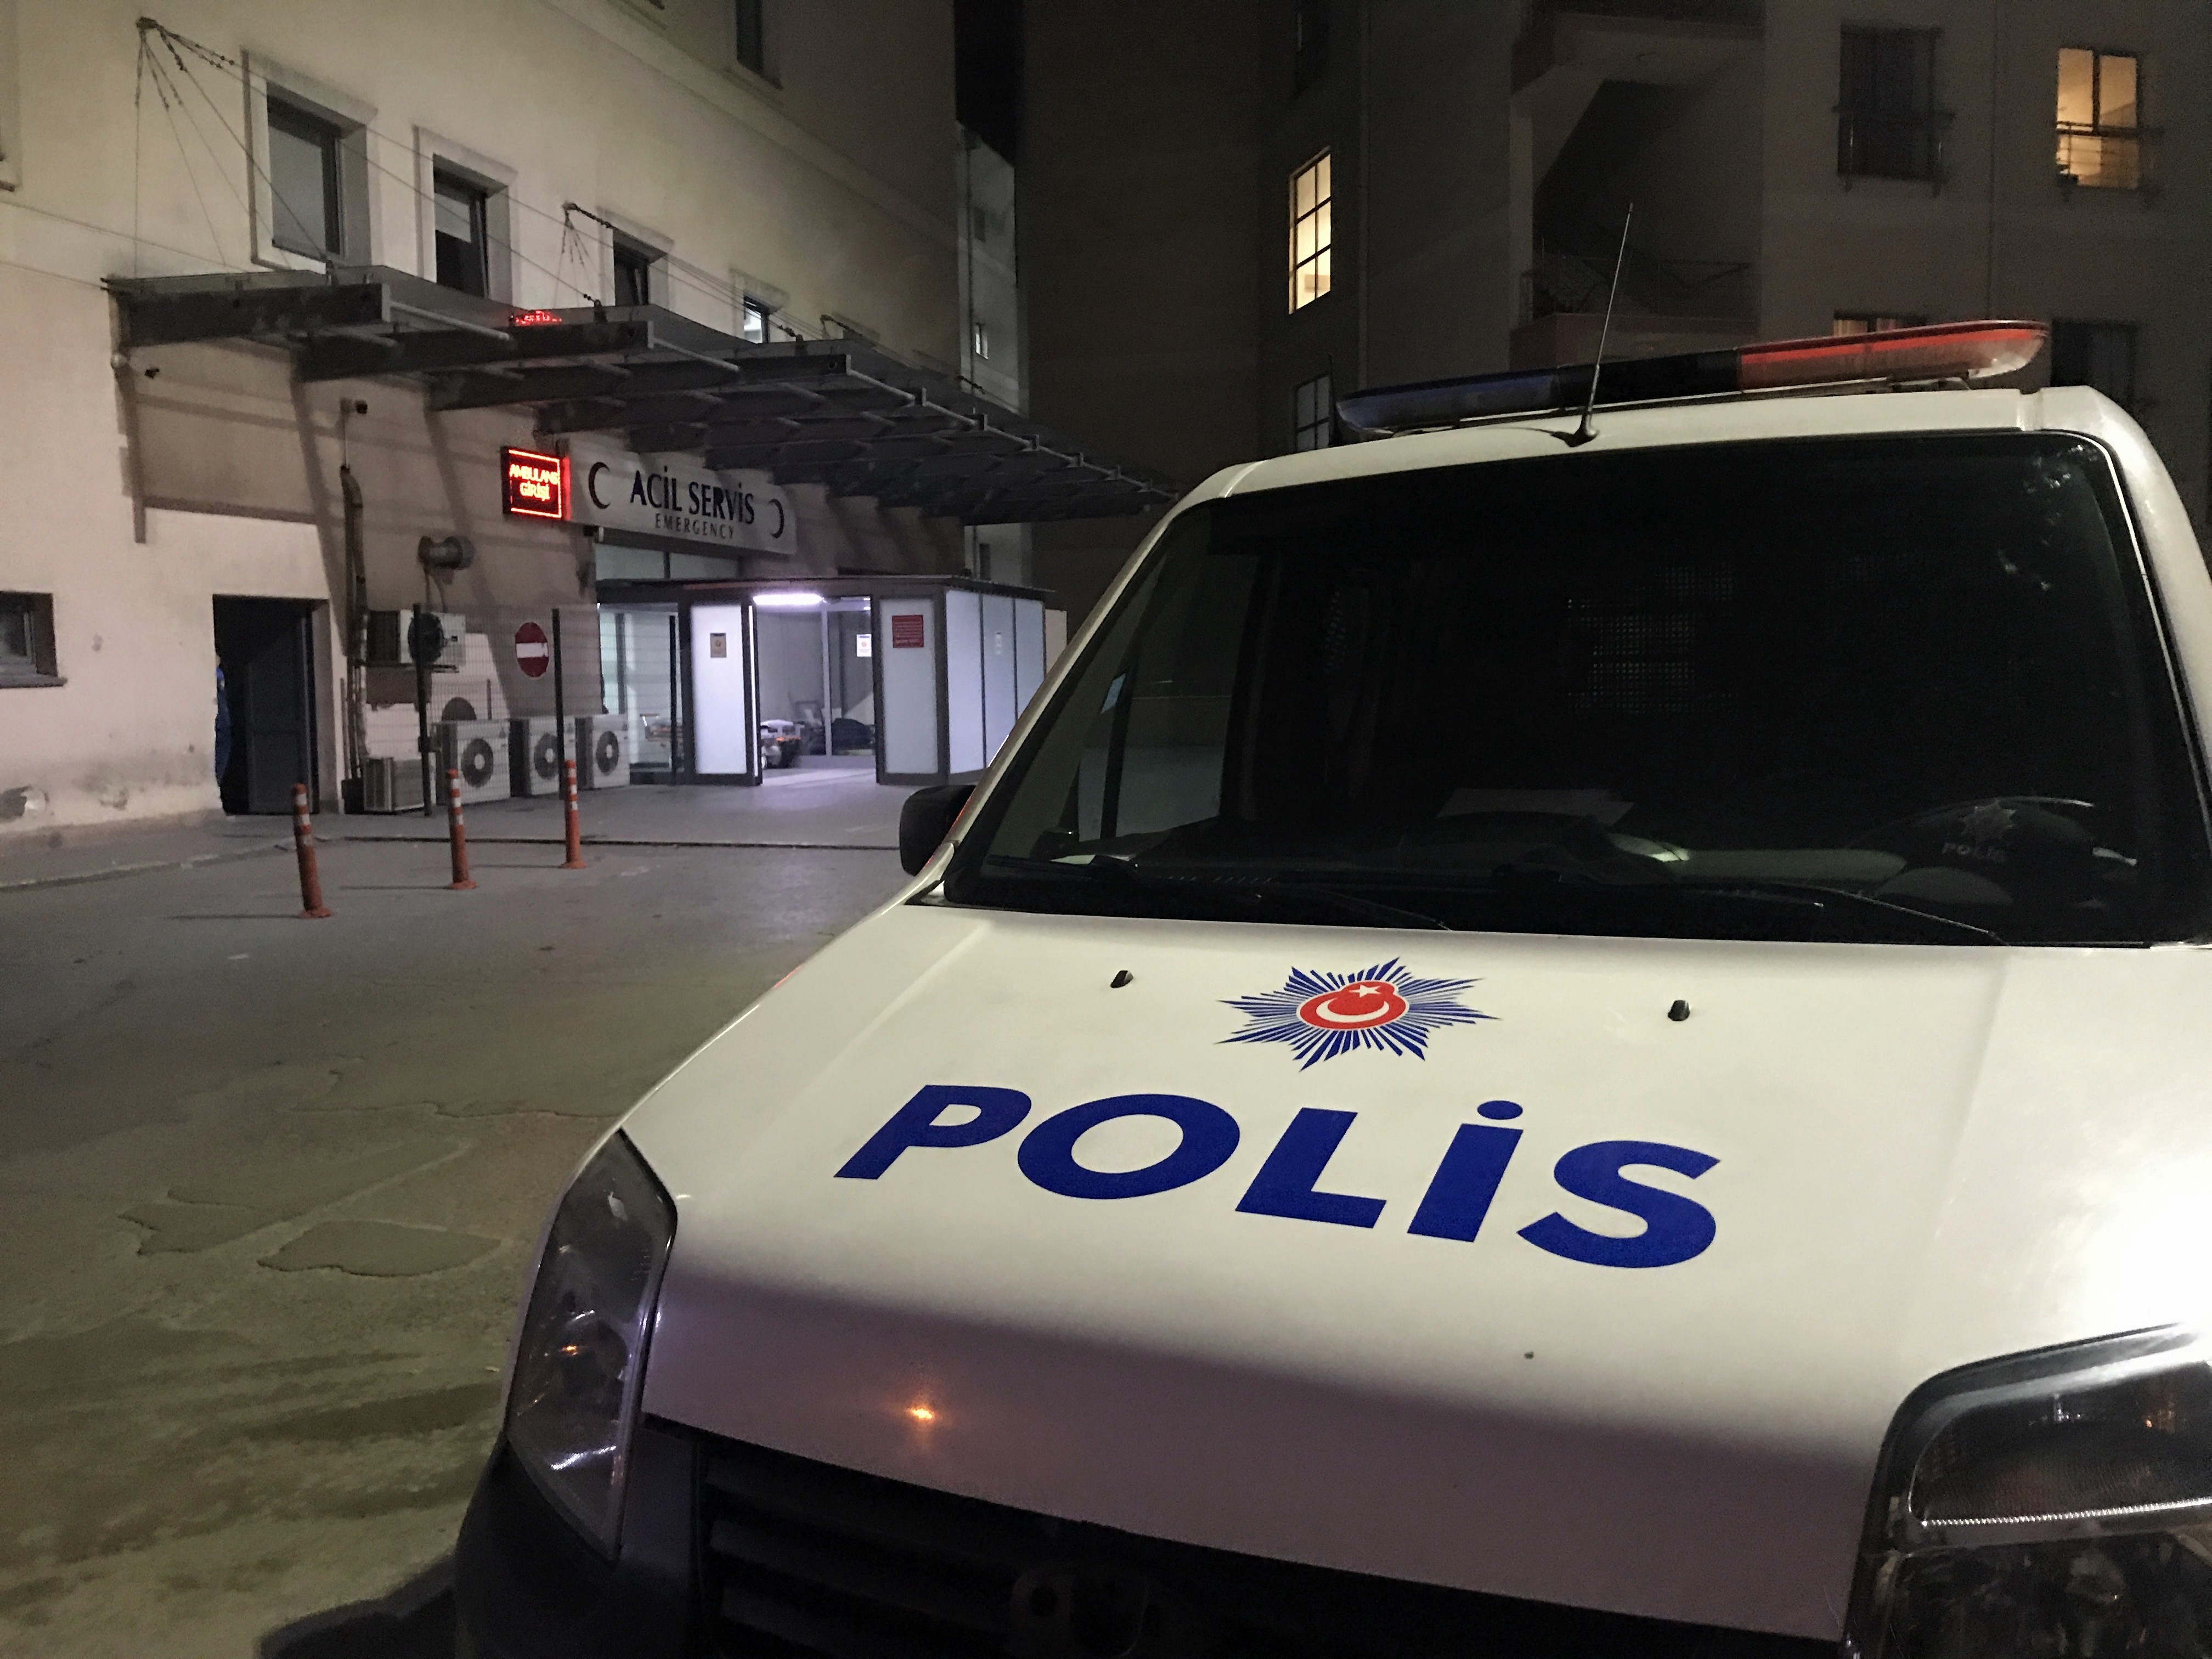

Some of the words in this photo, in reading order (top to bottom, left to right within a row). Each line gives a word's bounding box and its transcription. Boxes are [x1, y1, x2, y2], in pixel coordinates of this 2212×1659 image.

[509, 464, 558, 485] AMBULANS
[630, 466, 682, 511] ACİL
[689, 482, 755, 524] SERVİS
[655, 513, 734, 539] EMERGENCY
[834, 1084, 1719, 1268] POLİS
